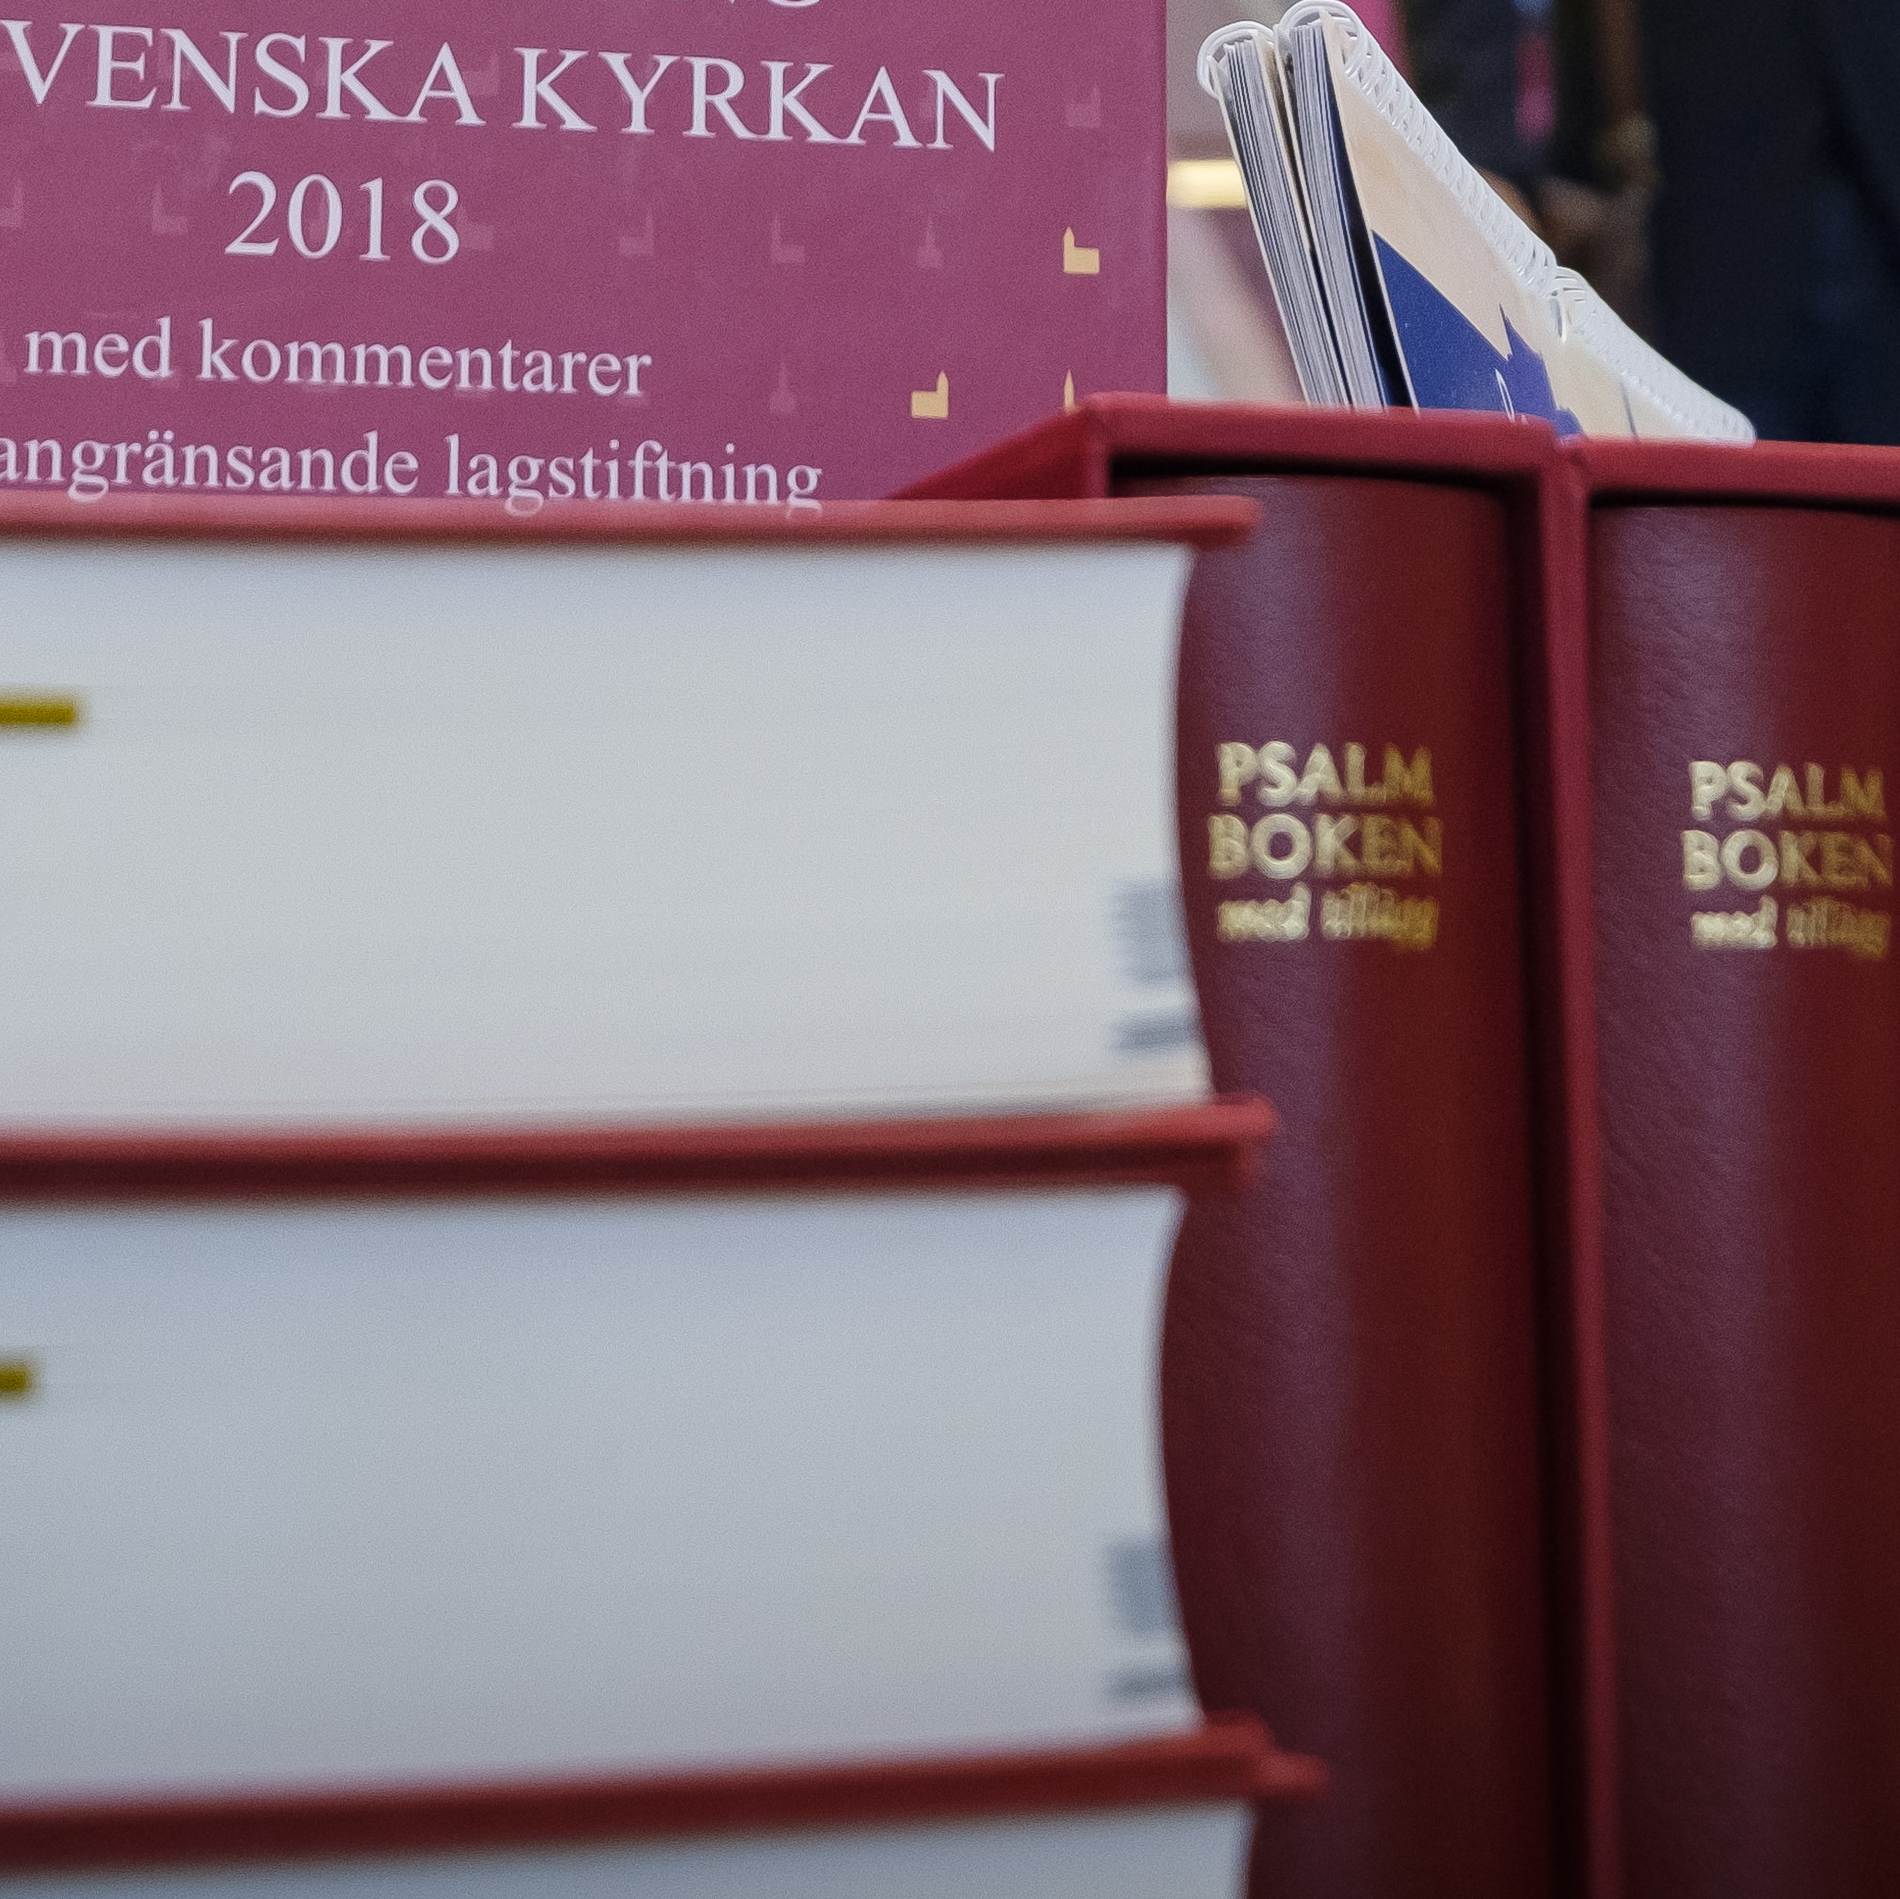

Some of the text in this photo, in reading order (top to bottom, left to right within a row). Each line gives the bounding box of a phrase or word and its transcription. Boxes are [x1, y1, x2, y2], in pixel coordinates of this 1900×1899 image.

[512, 46, 1006, 153] KYRKAN
[224, 169, 462, 265] 2018
[23, 316, 653, 398] med kommentarer
[444, 432, 823, 518] lagstiftning
[1216, 740, 1436, 808] PSALM
[1689, 760, 1886, 822] PSALM
[1208, 812, 1445, 881] BOKEN
[1681, 828, 1895, 893] BOKEN
